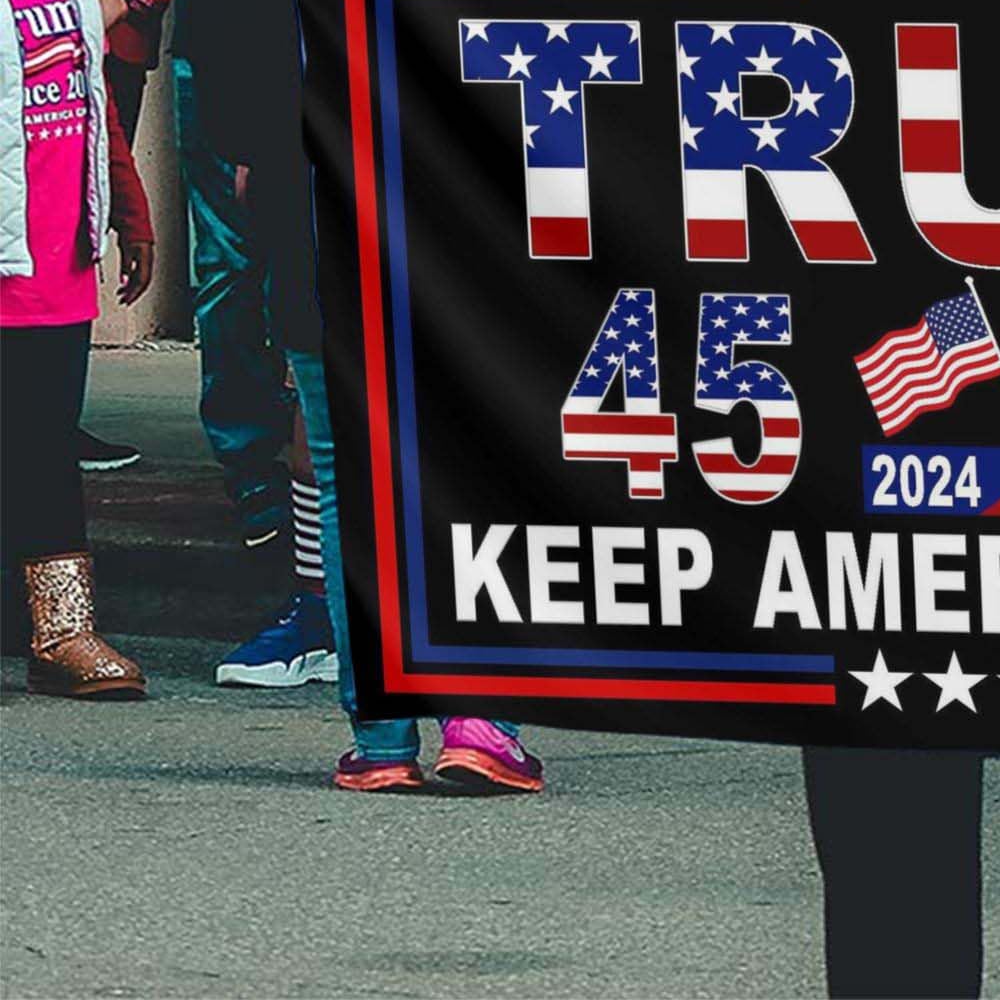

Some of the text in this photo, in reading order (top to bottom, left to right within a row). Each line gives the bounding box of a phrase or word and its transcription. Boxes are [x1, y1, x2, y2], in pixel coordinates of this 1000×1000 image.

[561, 288, 802, 505] 45
[871, 454, 982, 508] 2024
[451, 523, 713, 626] KEEP
